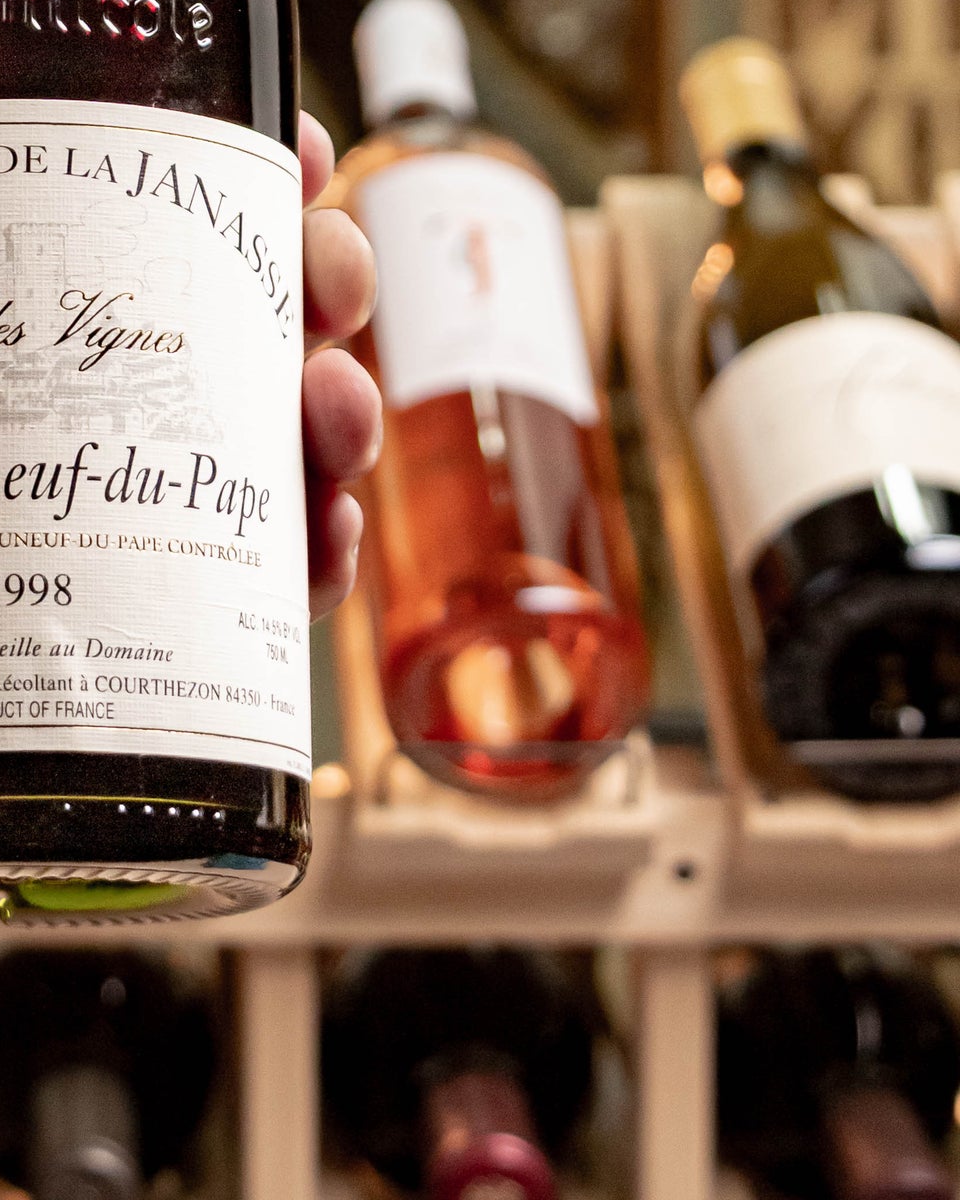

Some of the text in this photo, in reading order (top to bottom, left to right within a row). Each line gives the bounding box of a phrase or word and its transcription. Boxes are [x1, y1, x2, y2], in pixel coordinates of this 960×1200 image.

[64, 147, 118, 183] LA
[125, 149, 295, 339] JANASSE
[53, 290, 185, 372] Vignes
[261, 618, 282, 638] 145%
[48, 643, 76, 658] au
[84, 638, 174, 663] Domaine
[265, 643, 279, 661] 750
[79, 674, 89, 692] à
[94, 675, 222, 701] COURTHEZON
[225, 684, 261, 708] 84350
[28, 700, 50, 718] OF
[54, 700, 115, 720] FRANCE
